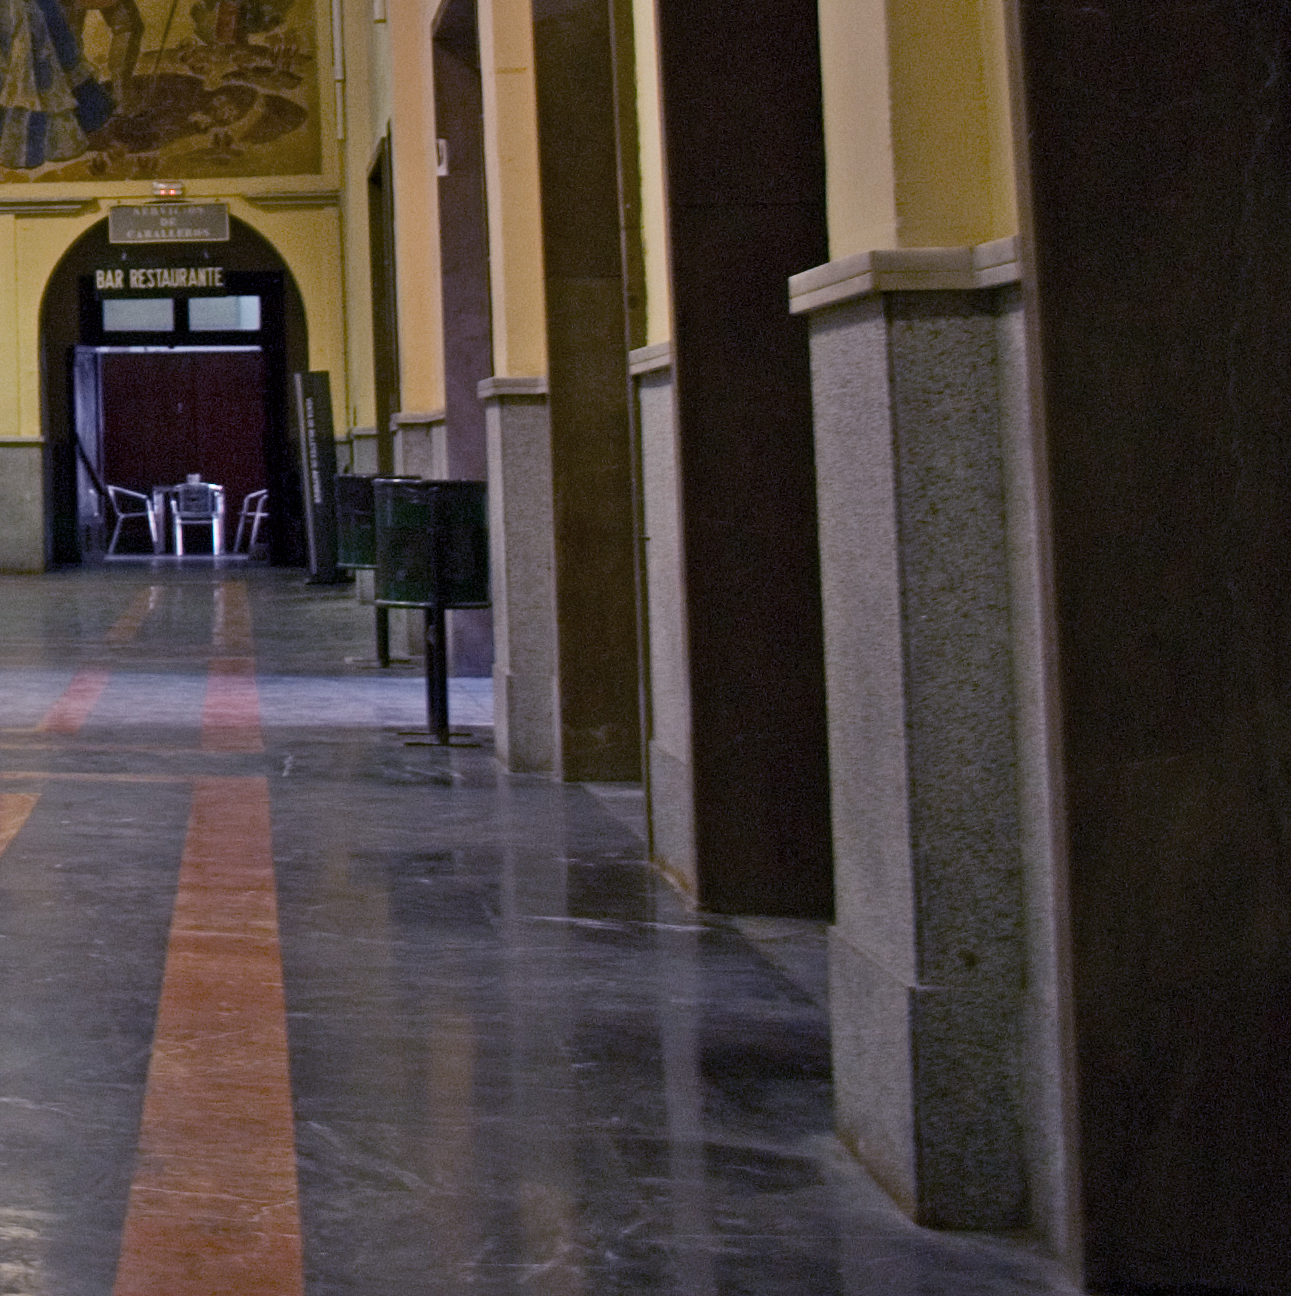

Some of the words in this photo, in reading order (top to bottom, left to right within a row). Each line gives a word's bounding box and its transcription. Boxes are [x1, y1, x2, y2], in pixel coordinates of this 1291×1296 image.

[159, 216, 177, 227] DE
[125, 228, 211, 239] CABALLEROS
[95, 268, 125, 290] BAR
[128, 266, 225, 289] RESTAURANTE
